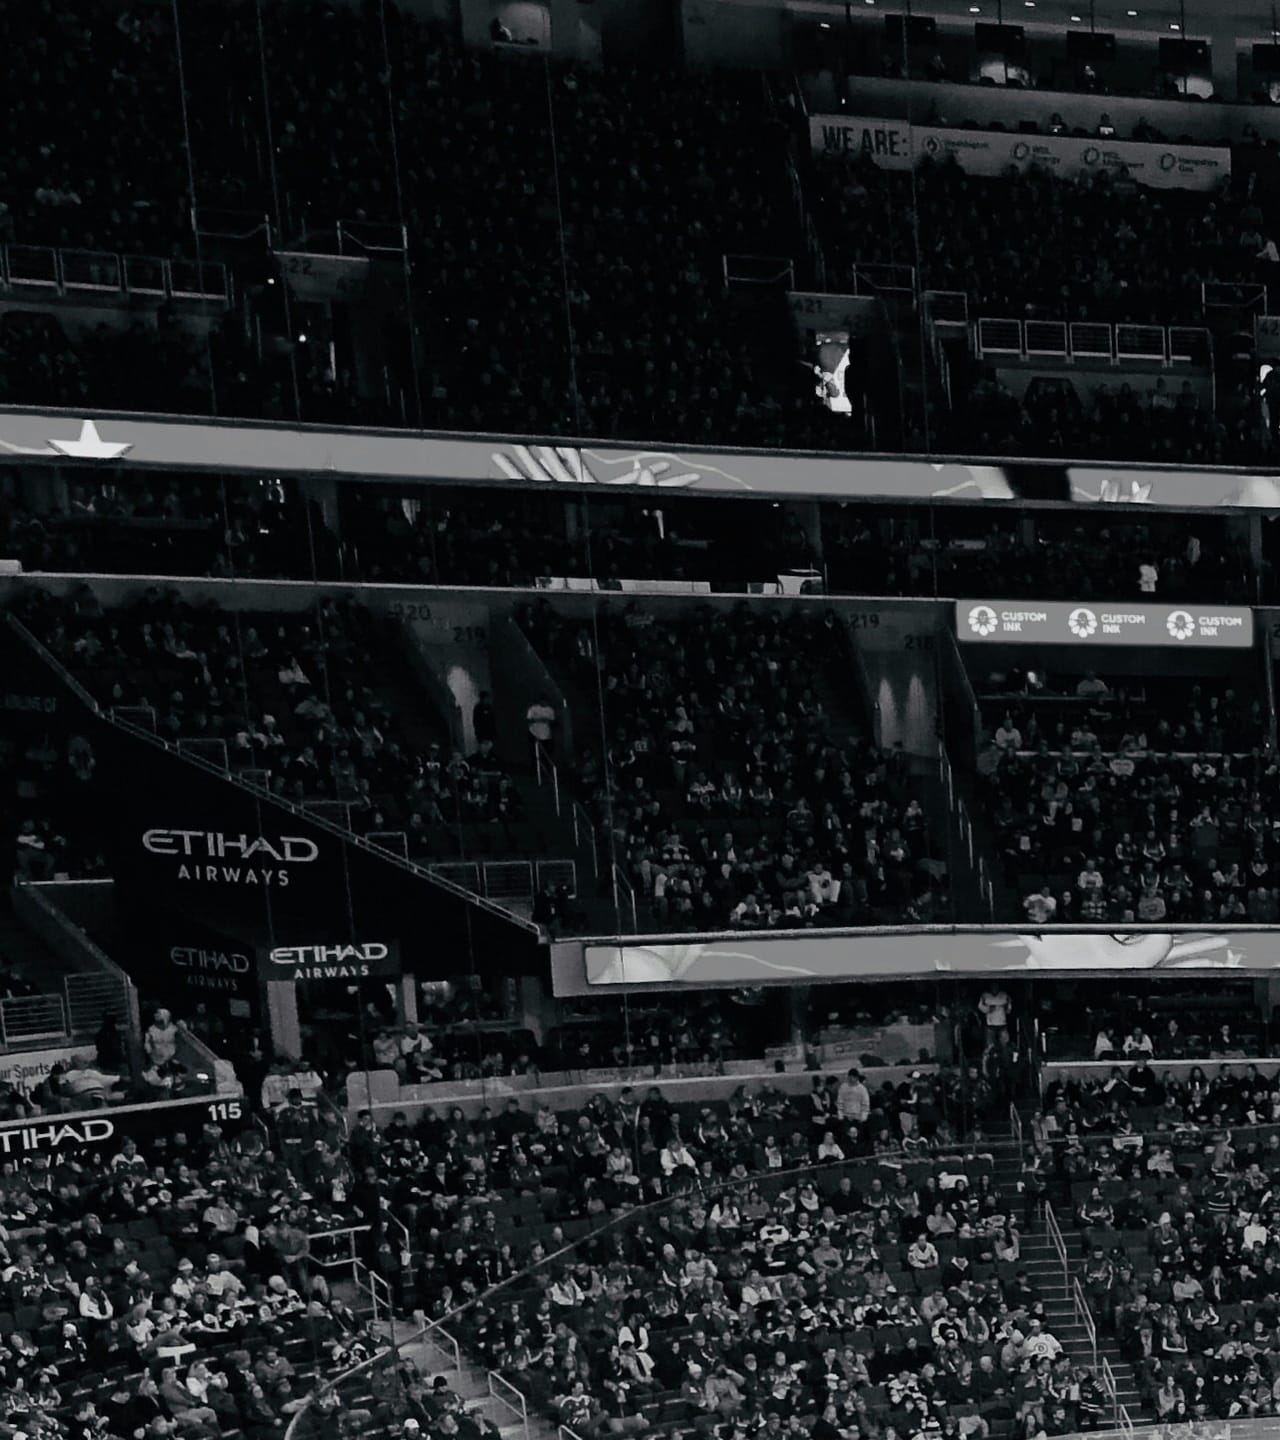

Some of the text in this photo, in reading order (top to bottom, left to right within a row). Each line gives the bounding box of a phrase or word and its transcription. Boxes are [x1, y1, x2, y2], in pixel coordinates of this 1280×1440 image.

[822, 125, 909, 157] WE ARE:
[848, 613, 880, 629] 219
[1001, 611, 1047, 623] CUSTOM
[1100, 613, 1146, 625] CUSTOM
[1198, 616, 1243, 627] CUSTOM
[452, 627, 486, 643] 219
[1003, 622, 1023, 633] INK
[1102, 624, 1122, 634] INK
[1199, 626, 1219, 637] INK
[141, 828, 320, 863] ETIHAD
[176, 863, 290, 888] AIRWAYS
[169, 944, 251, 974] ETIHAD
[268, 941, 389, 965] ETIHAD
[293, 963, 370, 980] AIRWAYS
[207, 1102, 243, 1121] 115
[0, 1119, 115, 1153] TIHAD
